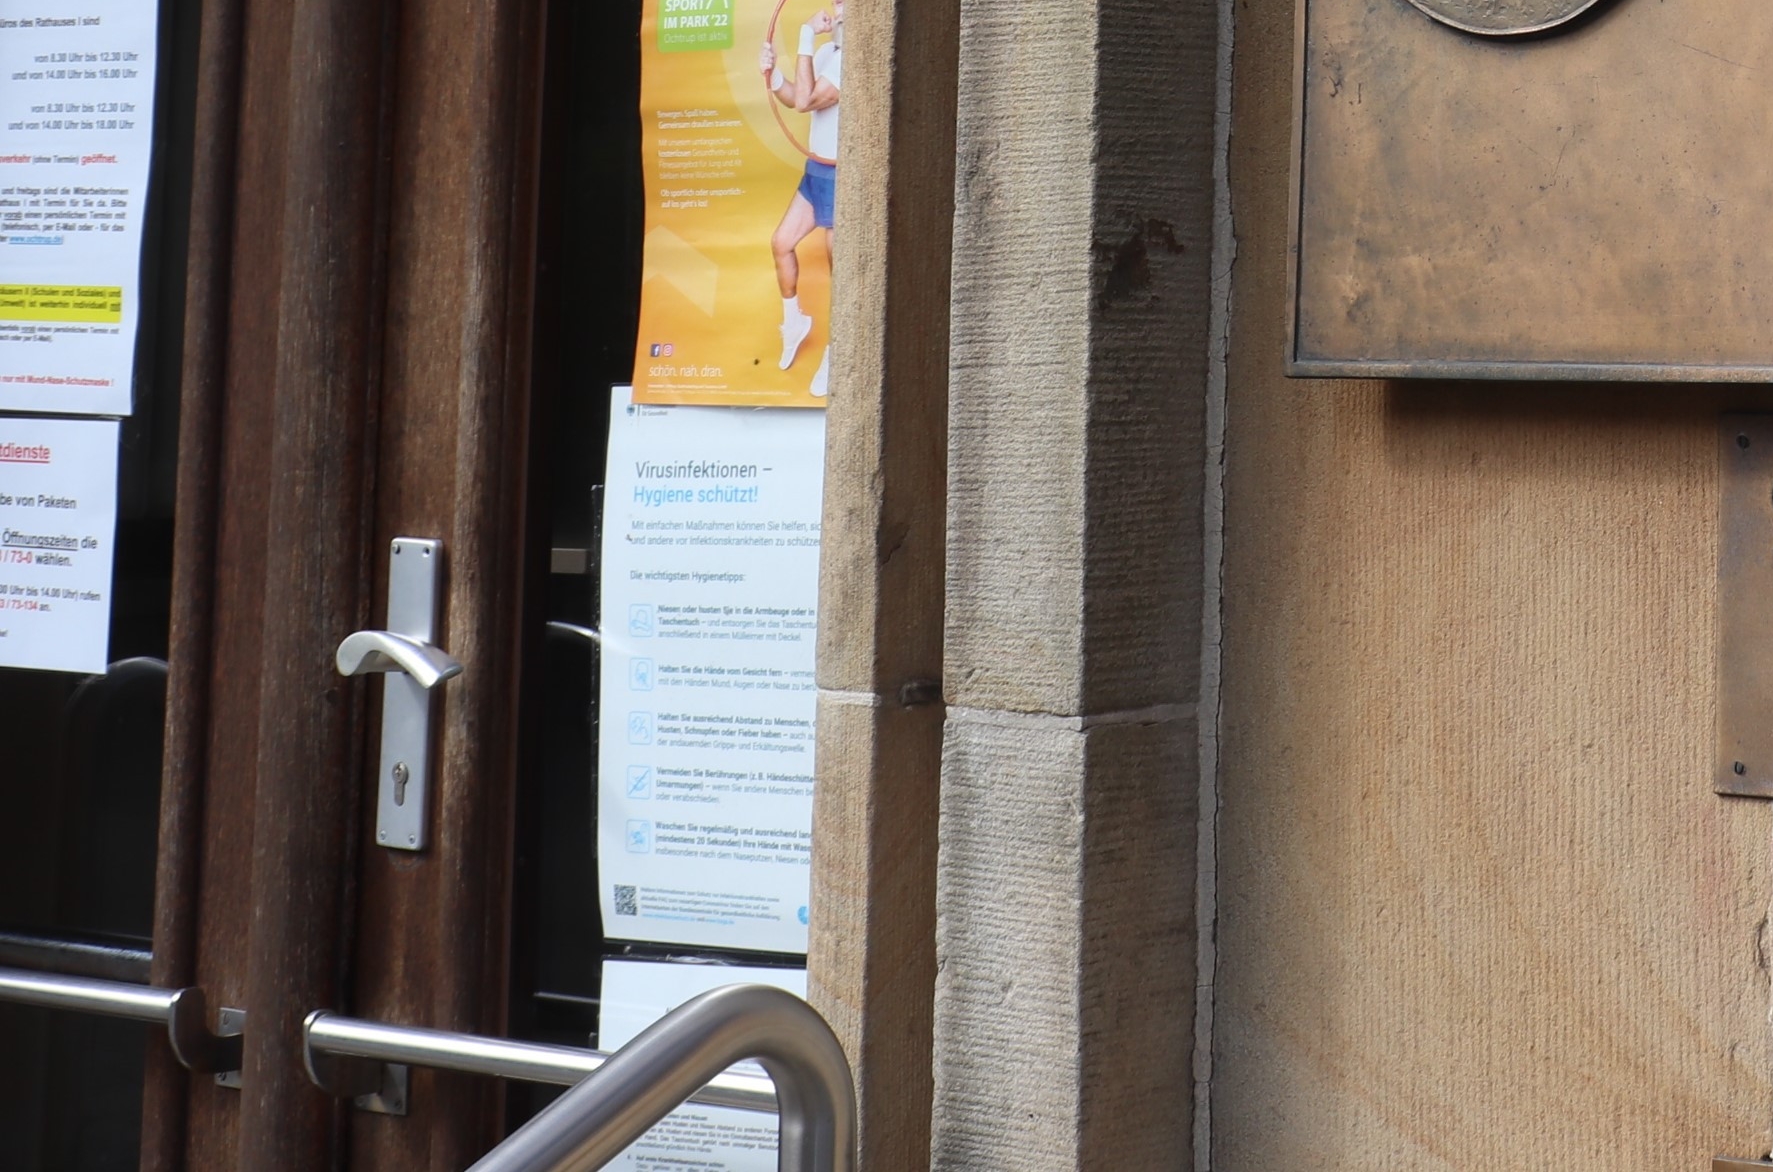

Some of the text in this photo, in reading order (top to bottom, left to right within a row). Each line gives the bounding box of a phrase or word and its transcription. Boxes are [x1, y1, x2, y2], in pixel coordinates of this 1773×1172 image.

[19, 16, 100, 28] des Rathauses sind
[664, 16, 677, 29] IM
[680, 15, 709, 28] PARK
[68, 52, 83, 62] Uhr
[84, 52, 98, 62] bis
[122, 52, 139, 62] Uhr
[68, 69, 82, 79] Uhr
[84, 69, 97, 79] bis
[122, 68, 138, 78] Uhr
[65, 103, 80, 113] Uhr
[82, 103, 94, 113] bis
[120, 102, 136, 112] Uhr
[64, 120, 79, 130] Uhr
[80, 120, 94, 129] bis
[118, 119, 135, 129] Uhr
[649, 365, 722, 377] schön. nah. dran.
[635, 460, 757, 478] Virusinfektionen
[15, 494, 76, 509] von Paketen
[634, 484, 758, 507] Hygiene schützt!
[631, 520, 644, 530] Mit
[646, 521, 684, 530] einfachen
[686, 521, 735, 531] Maßnahmen
[737, 521, 766, 530] können
[768, 521, 780, 531] Sie
[2, 528, 98, 549] Öffnungszeiten die
[647, 536, 673, 545] andere
[34, 552, 73, 567] wählen.
[630, 570, 747, 583] Die wichtigsten Hygienetipps:
[10, 584, 25, 596] Uhr
